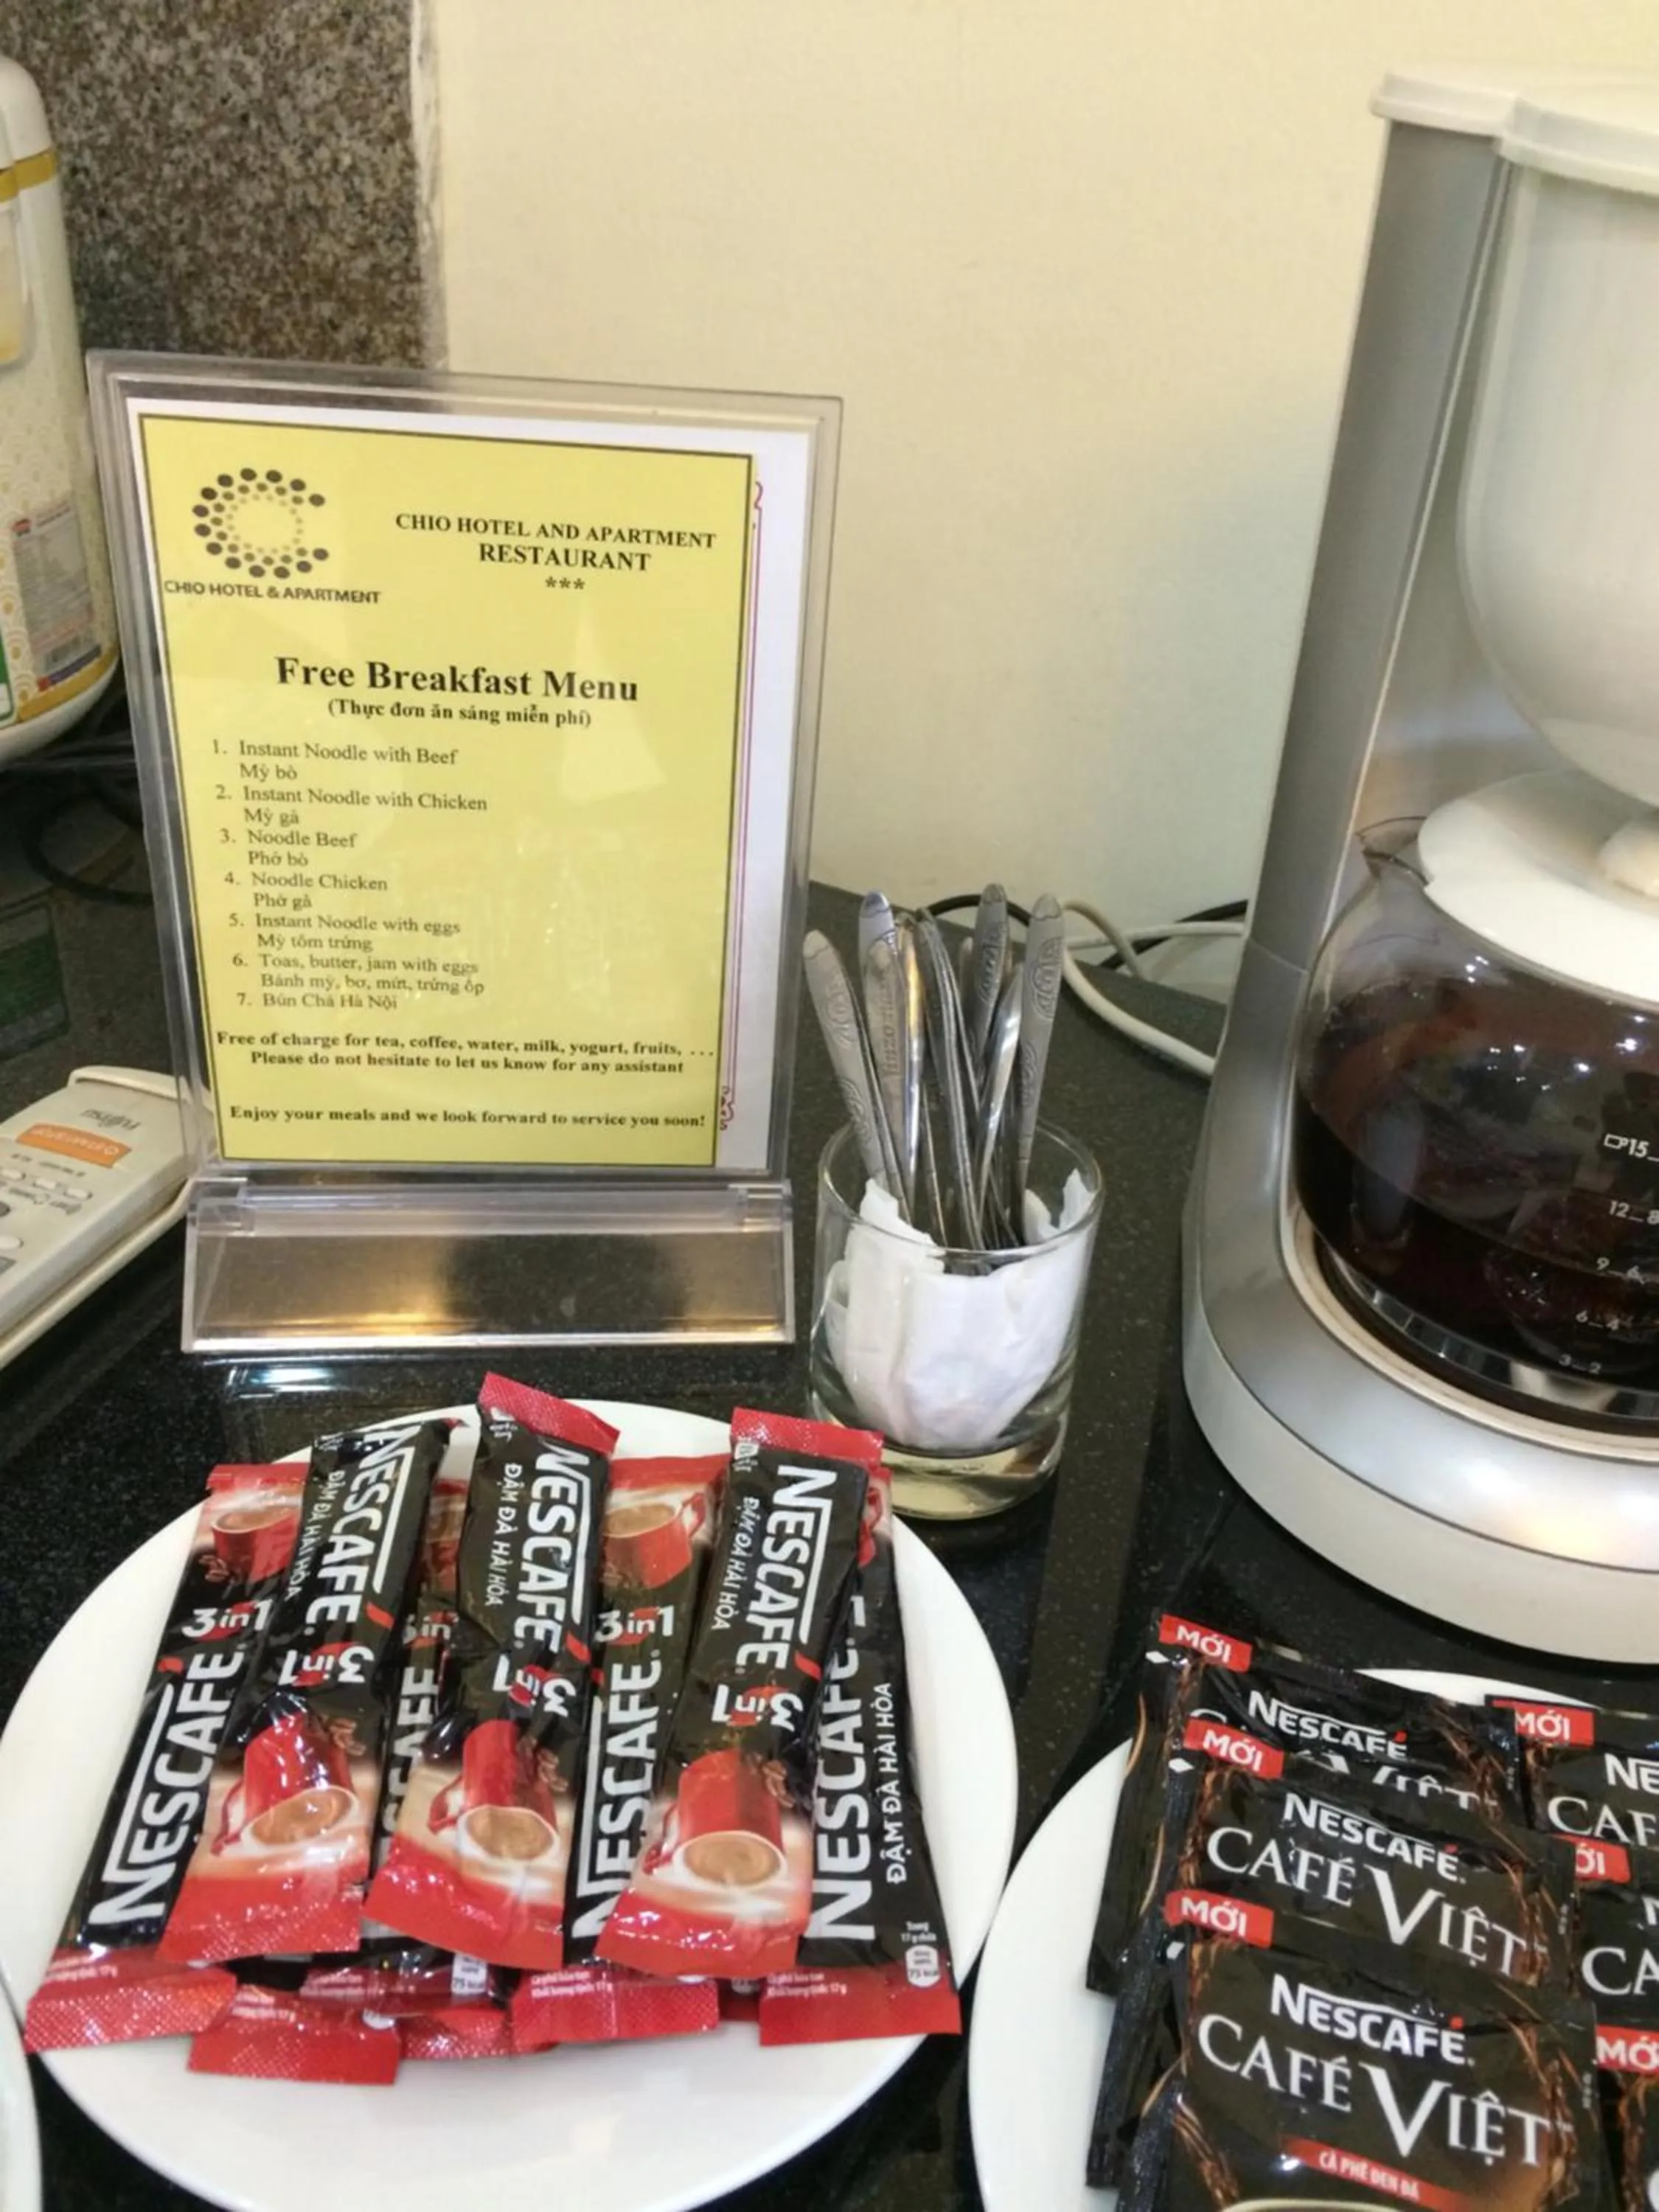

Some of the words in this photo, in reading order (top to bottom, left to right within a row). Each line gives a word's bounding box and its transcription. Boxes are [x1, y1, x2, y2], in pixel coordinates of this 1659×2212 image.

[396, 514, 451, 532] CHIO
[456, 518, 531, 538] HOTEL
[536, 524, 580, 540] AND
[585, 527, 717, 549] APARTMENT
[479, 543, 651, 571] RESTAURANT
[164, 580, 205, 594] CHIO
[209, 584, 262, 598] HOTEL
[268, 586, 282, 599] &
[282, 587, 381, 604] APARTMENT
[275, 656, 355, 686] Free
[366, 661, 532, 696] Breakfast
[543, 669, 638, 700] Menu
[459, 706, 500, 725] sáng
[213, 740, 228, 754] 1.
[240, 740, 299, 757] Instant
[305, 742, 367, 760] Noodle
[373, 748, 411, 762] with
[416, 749, 459, 765] Beef
[215, 785, 232, 799] 2.
[243, 785, 302, 802] Instant
[308, 788, 370, 805] Noodle
[376, 793, 413, 808] with
[418, 794, 487, 810] Chicken
[220, 828, 236, 844] 3.
[248, 829, 310, 846] Noodle
[316, 832, 358, 847] Beef
[224, 872, 240, 884] 4.
[252, 872, 313, 887] Noodle
[319, 874, 388, 891] Chicken
[229, 913, 244, 927] 5.
[256, 913, 312, 928] Instant
[318, 914, 377, 931] Noodle
[383, 917, 418, 932] with
[424, 922, 460, 937] eggs
[232, 953, 248, 967] 6.
[259, 953, 305, 968] Toas,
[310, 954, 362, 971] butter,
[366, 956, 397, 973] jam
[402, 959, 437, 972] with
[442, 962, 479, 976] eggs
[237, 992, 252, 1006] 7.
[217, 1032, 255, 1046] Free
[260, 1032, 278, 1046] of
[282, 1032, 339, 1049] charge
[344, 1034, 369, 1046] for
[375, 1035, 404, 1048] tea,
[409, 1035, 462, 1050] coffee,
[467, 1039, 518, 1054] water,
[524, 1040, 565, 1053] milk,
[570, 1042, 629, 1056] yogurt,
[633, 1041, 682, 1057] fruits,
[251, 1051, 304, 1065] Please
[309, 1052, 329, 1065] do
[335, 1054, 361, 1065] not
[367, 1054, 429, 1068] hesitate
[436, 1057, 451, 1068] to
[456, 1055, 475, 1068] let
[481, 1060, 498, 1070] us
[504, 1058, 546, 1071] know
[552, 1059, 574, 1071] for
[581, 1062, 608, 1074] any
[614, 1060, 684, 1073] assistant
[230, 1106, 278, 1122] Enjoy
[285, 1110, 322, 1122] your
[329, 1109, 375, 1121] meals
[380, 1110, 410, 1121] and
[416, 1112, 438, 1121] we
[443, 1110, 477, 1123] look
[481, 1111, 547, 1124] forward
[552, 1113, 567, 1124] to
[571, 1114, 626, 1126] service
[630, 1116, 658, 1128] you
[664, 1115, 705, 1127] soon!
[1629, 1138, 1649, 1157] 15
[1609, 1200, 1630, 1218] 12
[1646, 1210, 1659, 1225] 8
[1597, 1257, 1610, 1270] 9
[1576, 1310, 1588, 1323] 6
[1559, 1354, 1571, 1366] 3
[1177, 1625, 1231, 1663] MỚI
[870, 1683, 894, 1728] HÒA
[1514, 1710, 1571, 1740] MỚI
[873, 1734, 898, 1773] HÀI
[1203, 1730, 1263, 1772] MỚI
[875, 1779, 903, 1815] ĐÀ
[1283, 1793, 1460, 1882] NESCAFÉ
[880, 1820, 913, 1885] ĐẬM
[1576, 1843, 1605, 1876] ỚI
[1207, 1827, 1357, 1907] CAFÉ
[1364, 1863, 1526, 1976] VIỆT
[1181, 1896, 1247, 1936] MỚI
[1270, 1972, 1467, 2065] NESCAFÉ
[1198, 2014, 1352, 2112] CAFÉ
[1359, 2062, 1551, 2167] VIỆT
